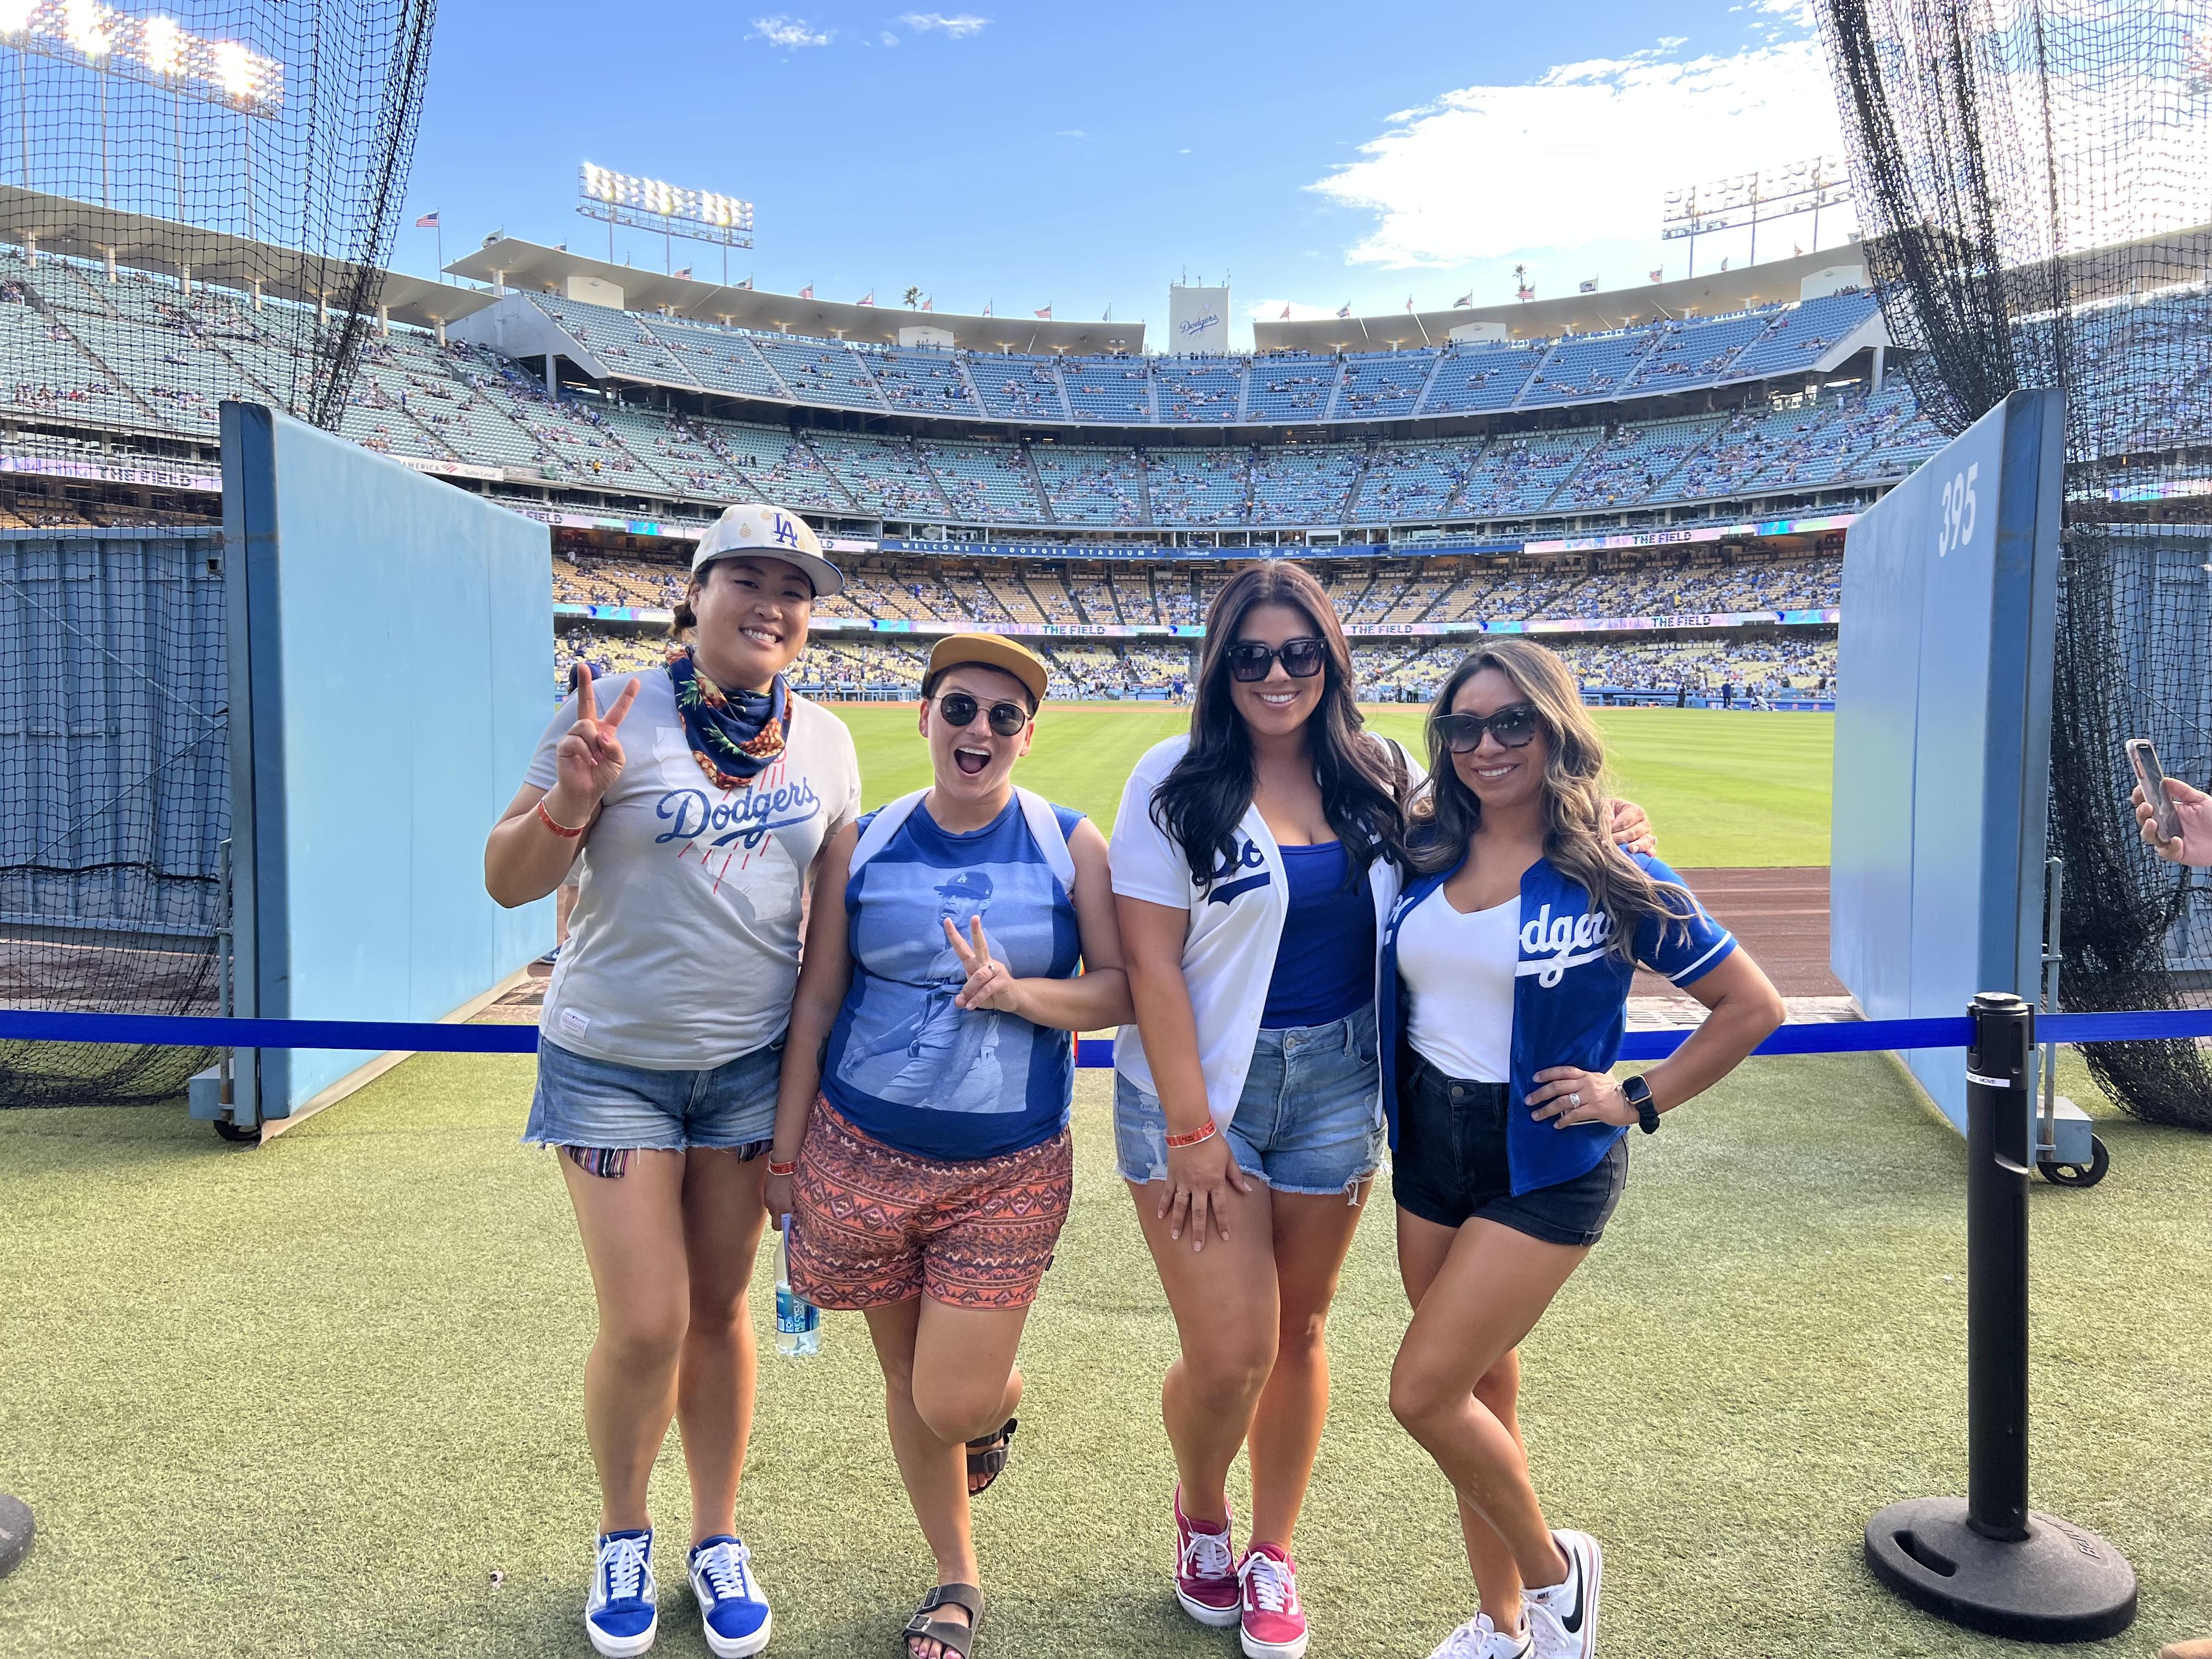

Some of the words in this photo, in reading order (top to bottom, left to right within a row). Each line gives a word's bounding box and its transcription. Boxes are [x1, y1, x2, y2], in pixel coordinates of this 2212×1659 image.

[1180, 314, 1219, 335] Dodgers
[96, 465, 134, 481] THE
[140, 470, 191, 487] FIELD
[1939, 461, 1978, 557] 395
[773, 512, 797, 549] LA
[1633, 535, 1655, 545] THE
[1658, 532, 1691, 544] FIELD
[902, 542, 969, 552] WELCOME
[1043, 625, 1066, 635] THE
[1070, 626, 1105, 635] FIELD
[1350, 625, 1374, 634] THE
[1379, 624, 1413, 634] FIELD
[1651, 617, 1674, 627] THE
[1677, 616, 1711, 627] FIELD
[655, 776, 821, 849] Dodgers
[1520, 904, 1613, 988] dger
